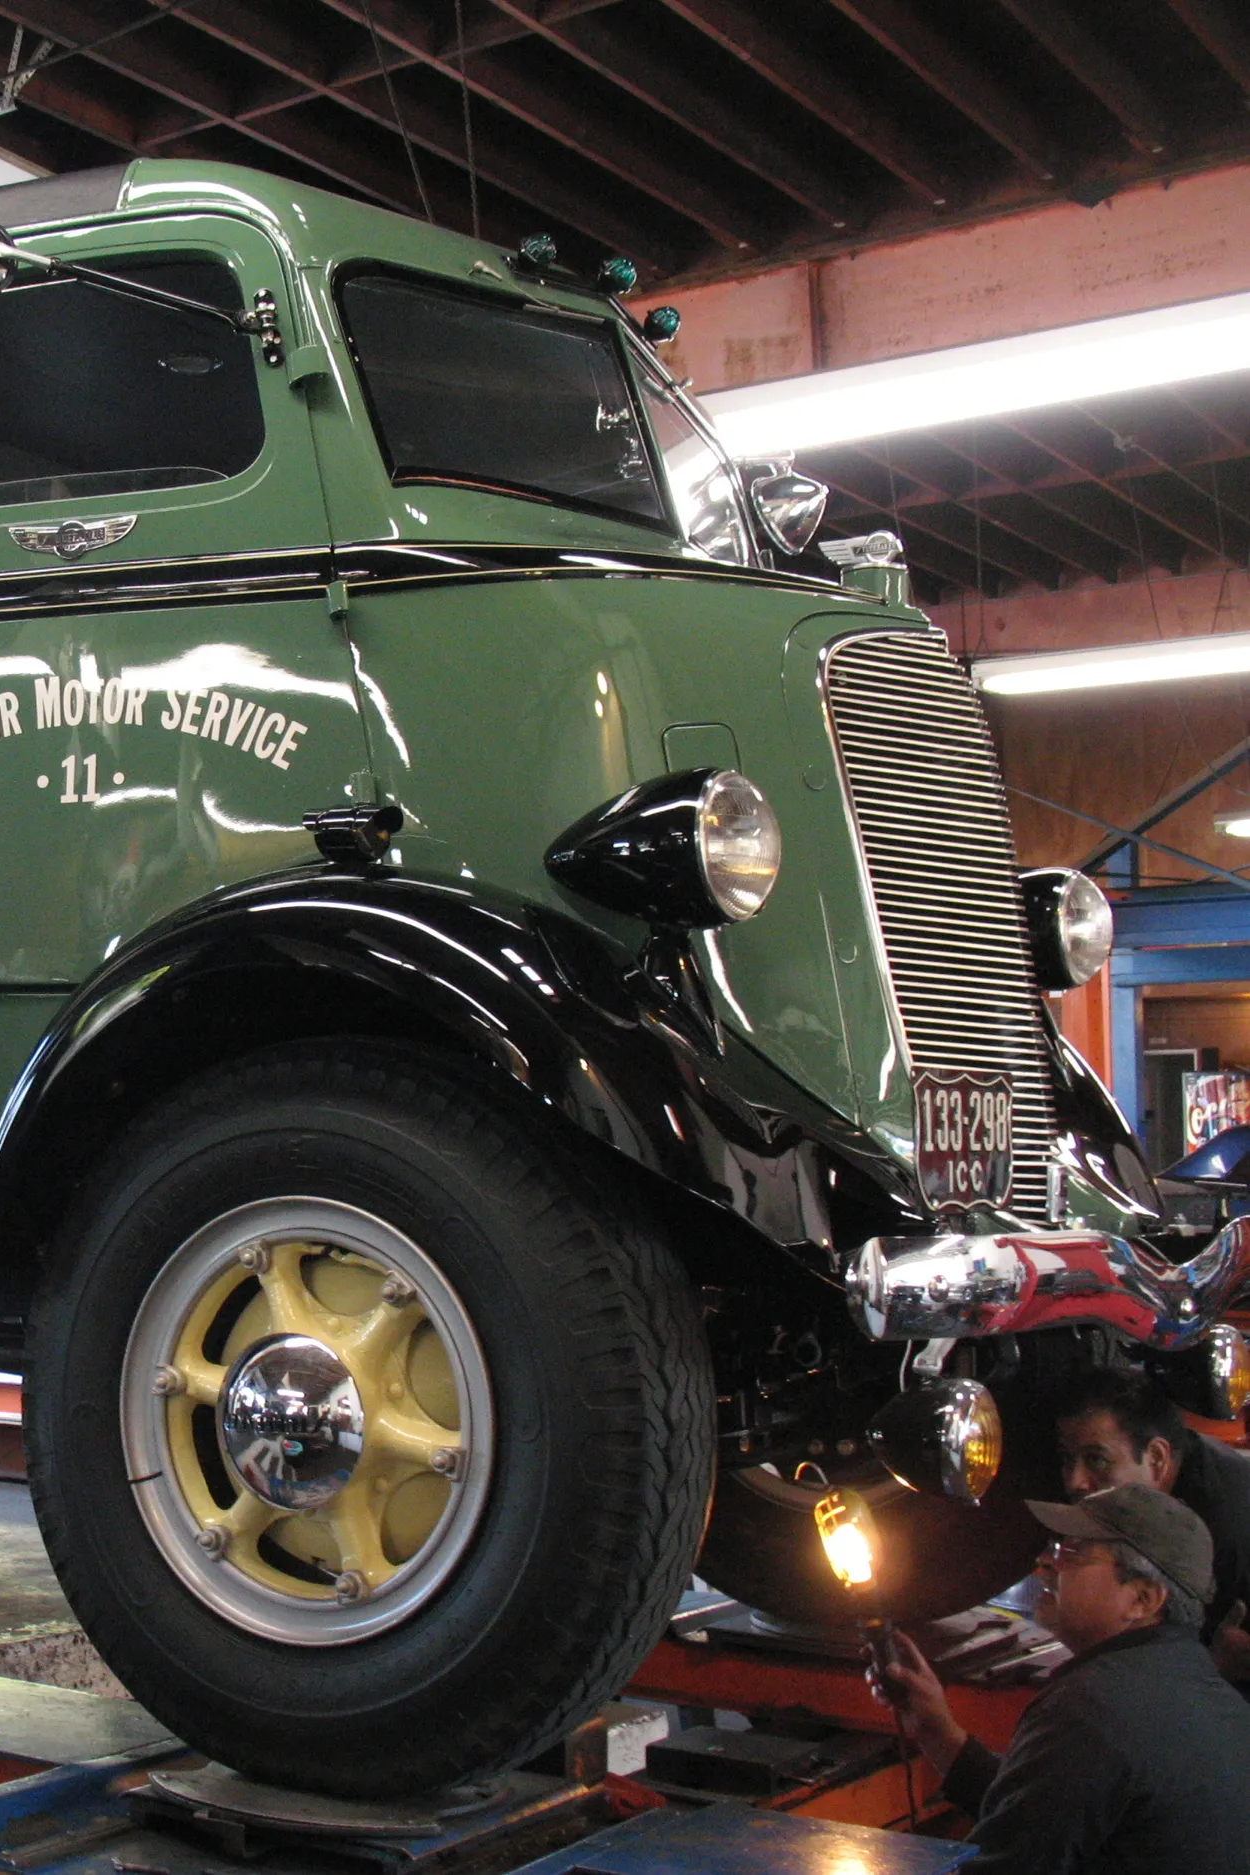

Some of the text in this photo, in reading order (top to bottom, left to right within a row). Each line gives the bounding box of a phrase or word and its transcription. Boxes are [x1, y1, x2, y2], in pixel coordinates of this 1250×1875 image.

[34, 675, 147, 731] MOTOR
[161, 687, 308, 770] SERVICE
[923, 1089, 1007, 1152] 133-298
[948, 1159, 984, 1194] ICC
